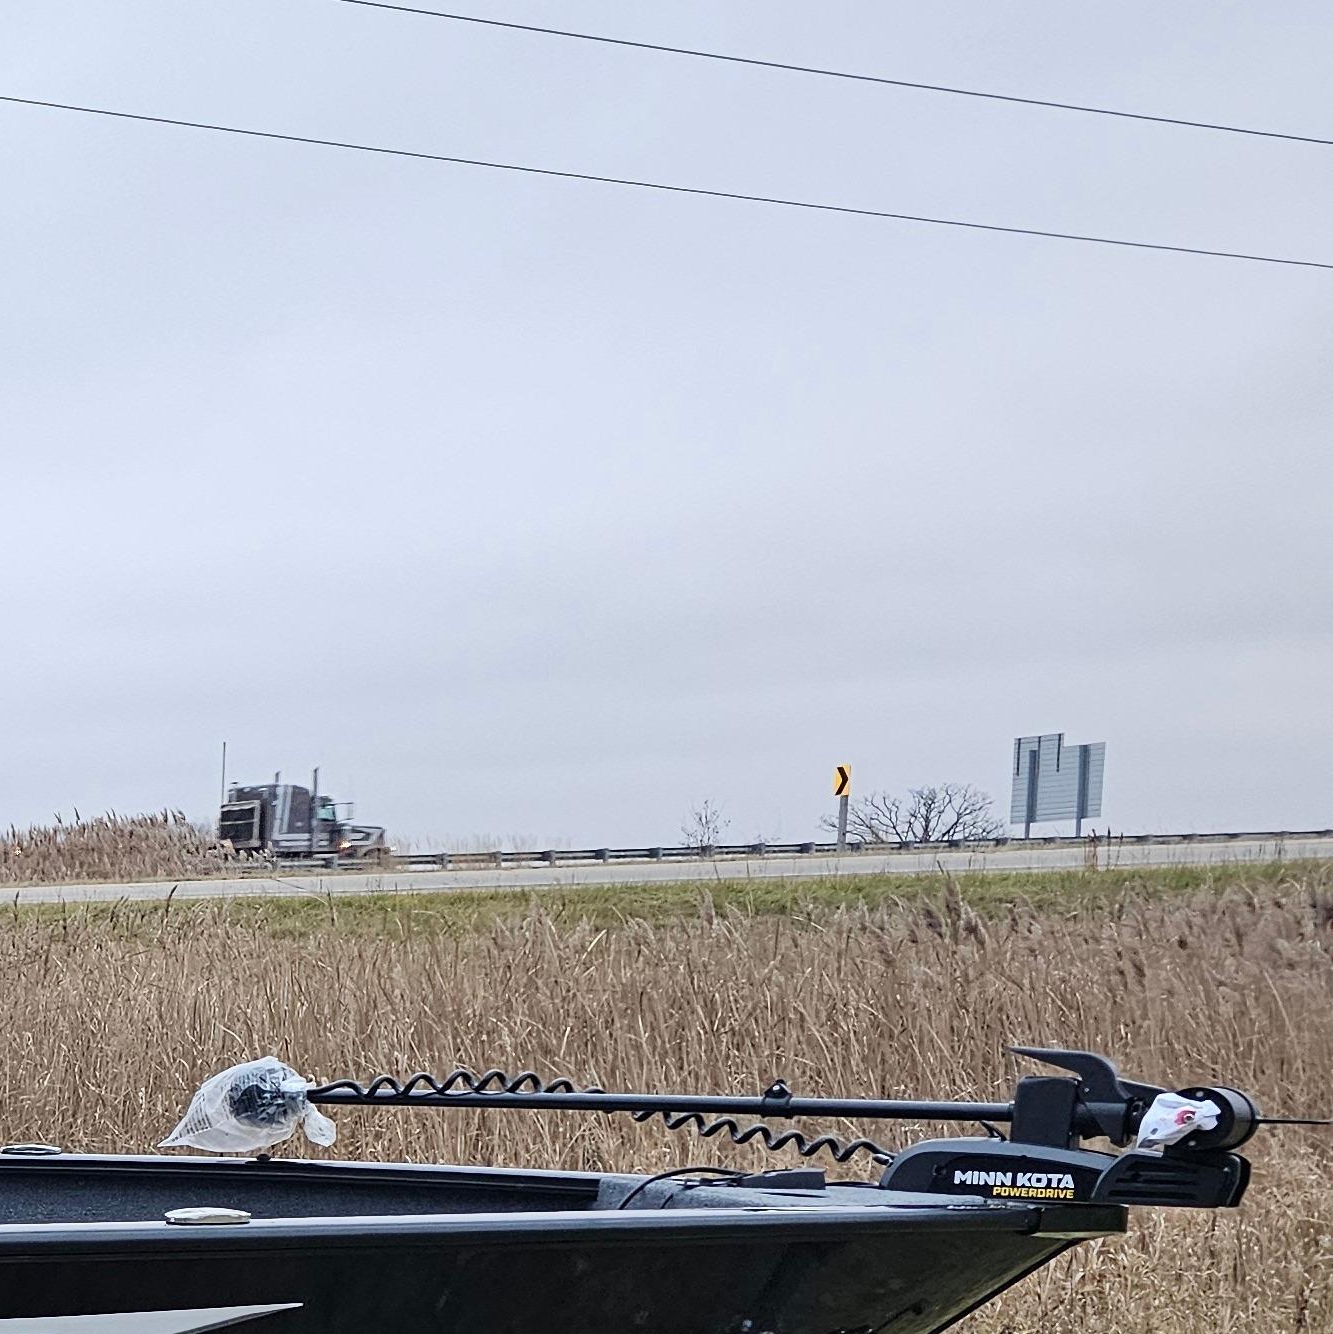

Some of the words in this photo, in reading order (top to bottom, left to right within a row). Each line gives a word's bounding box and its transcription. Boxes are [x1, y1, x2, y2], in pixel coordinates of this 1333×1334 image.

[953, 1170, 1013, 1186] MINN
[1016, 1172, 1075, 1189] KOTA
[992, 1186, 1075, 1199] POWERDRIVE
